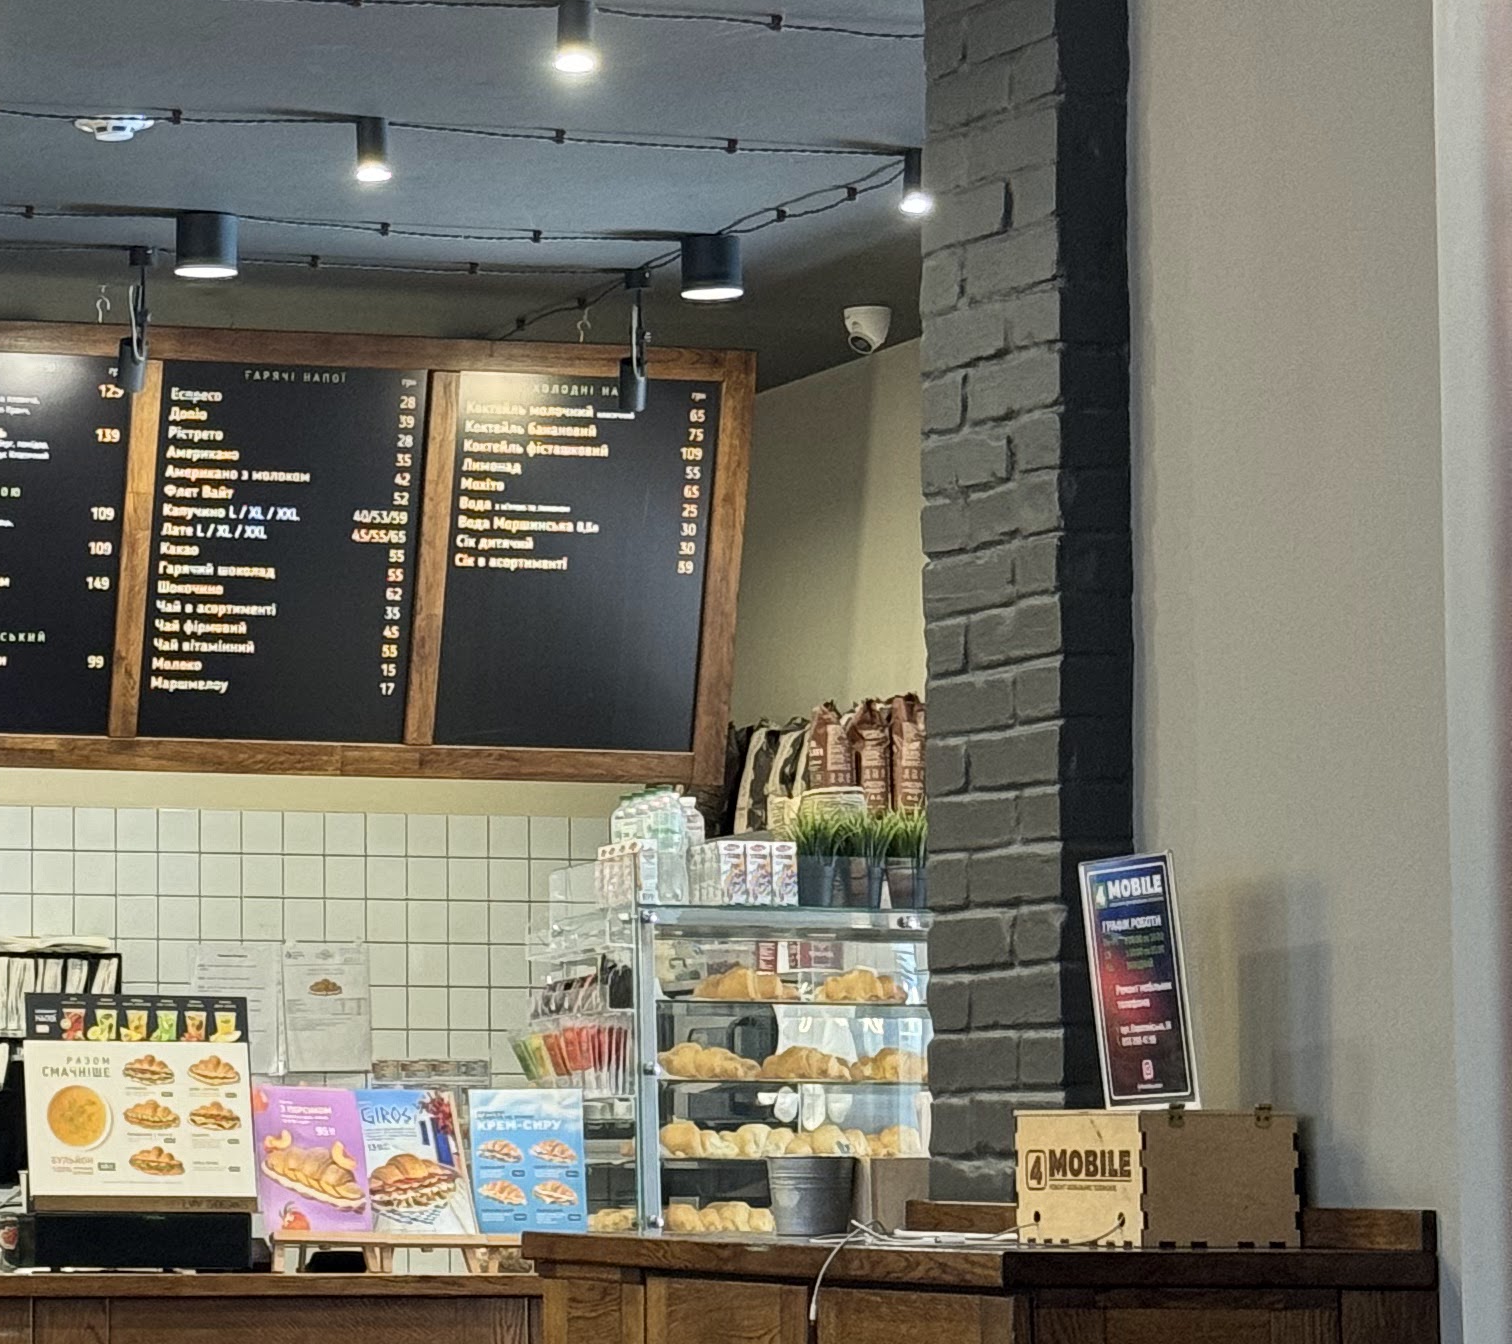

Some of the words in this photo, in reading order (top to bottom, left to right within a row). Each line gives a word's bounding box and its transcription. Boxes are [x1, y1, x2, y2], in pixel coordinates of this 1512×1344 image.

[245, 370, 295, 382] ГАРЯЧІ
[303, 372, 347, 383] НАПОЇ
[170, 387, 223, 404] Еспресо
[399, 395, 416, 409] 28
[168, 406, 208, 422] Допіо
[398, 415, 415, 428] 39
[529, 404, 594, 418] молочний
[689, 409, 706, 423] 65
[95, 429, 121, 443] 139
[167, 425, 224, 443] Рістрето
[397, 434, 414, 448] 28
[464, 419, 525, 435] Коктейль
[527, 422, 597, 438] банановий
[688, 428, 704, 442] 75
[166, 445, 240, 462] Американо
[395, 453, 412, 467] 35
[463, 438, 524, 454] Коктейль
[526, 440, 609, 458] фісташковий
[680, 447, 703, 461] 109
[165, 464, 238, 482] Американо
[252, 470, 311, 483] молоком
[394, 472, 411, 486] 42
[685, 466, 701, 480] 55
[201, 485, 235, 499] Вайт
[392, 492, 409, 505] 52
[90, 507, 115, 520] 109
[162, 503, 226, 520] Капучино
[228, 505, 237, 519] L
[459, 496, 492, 511] Вода
[681, 504, 698, 518] 25
[457, 515, 491, 531] Вода
[493, 516, 574, 533] Моршинська
[680, 522, 697, 536] 30
[159, 541, 200, 556] Какао
[388, 549, 405, 562] 55
[158, 561, 214, 577] Гарячий
[217, 566, 276, 580] шоколад
[386, 568, 404, 582] 55
[488, 556, 568, 572] асортименті
[86, 576, 110, 590] 149
[385, 588, 402, 601] 62
[156, 599, 182, 613] Чай
[196, 603, 277, 618] асортименті
[155, 618, 180, 632] Чай
[183, 619, 248, 635] фірмовий
[382, 625, 400, 639] 45
[153, 637, 179, 652] Чай
[182, 639, 255, 653] вітамінний
[87, 655, 104, 669] 99
[152, 657, 202, 671] Молоко
[380, 663, 397, 677] 15
[379, 682, 395, 695] 17
[1106, 873, 1163, 900] MOBILE
[66, 1056, 110, 1066] РАЗОМ
[41, 1066, 111, 1078] СМАЧНІШЕ
[360, 1103, 412, 1125] GIROS
[476, 1119, 562, 1131] КРЕМ-СИРУ
[1029, 1154, 1043, 1186] 4
[1048, 1148, 1132, 1178] MOBILE
